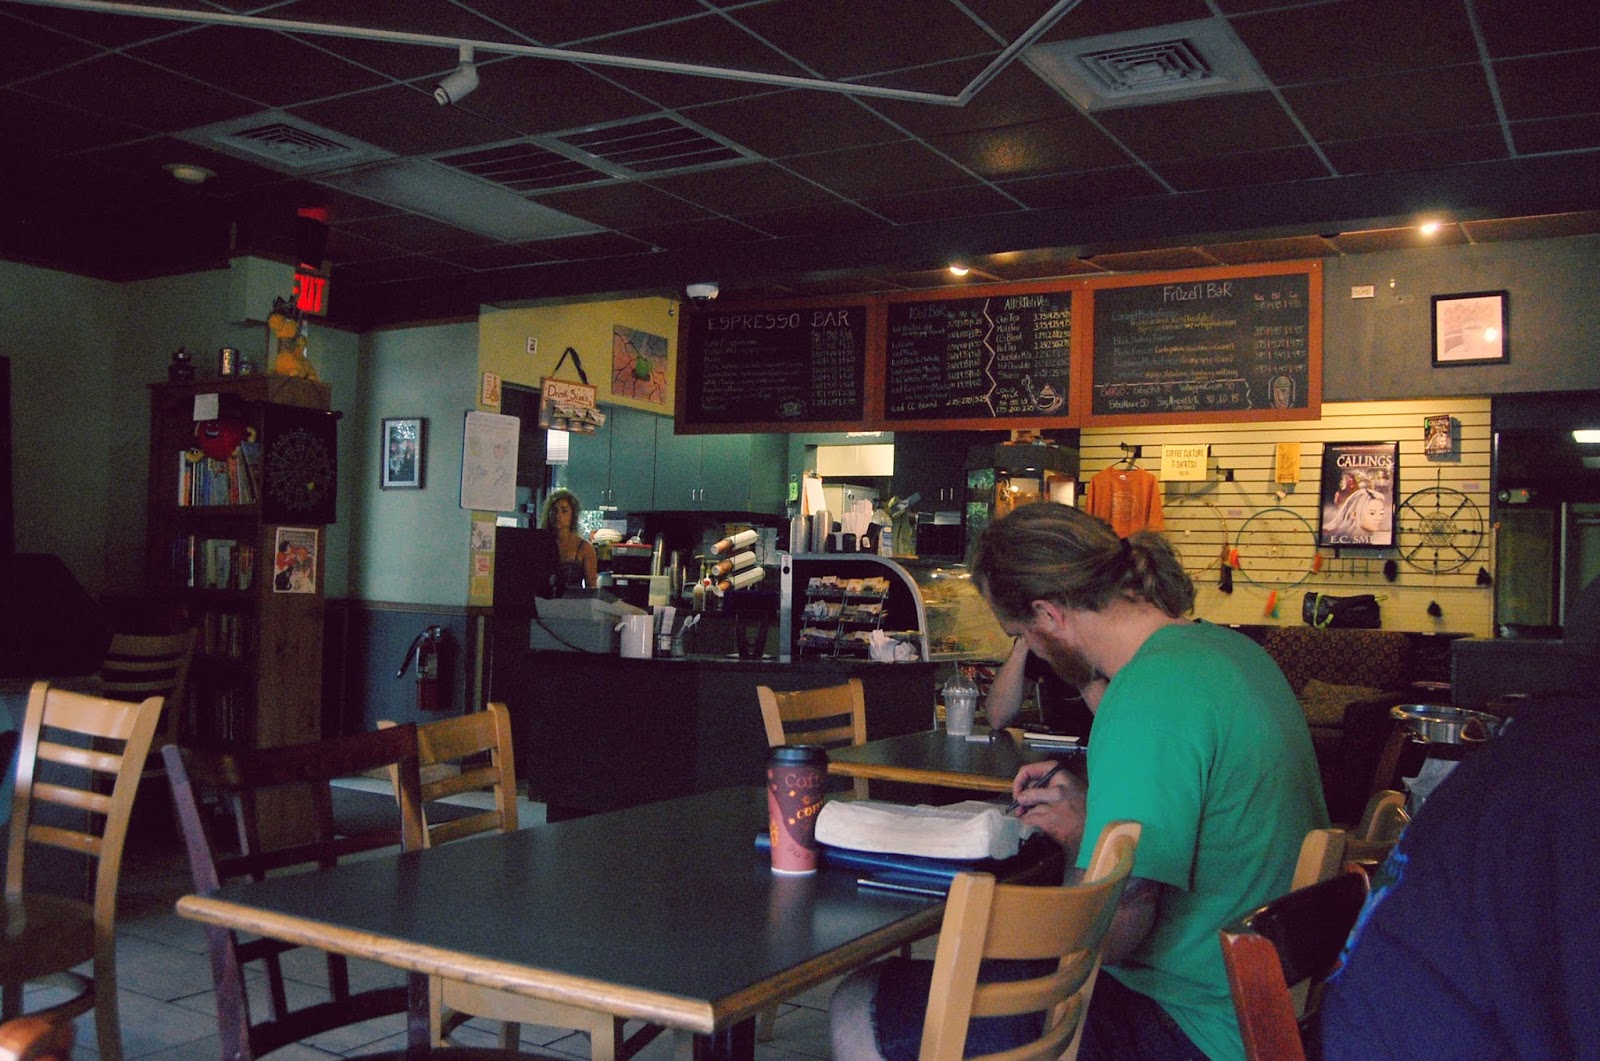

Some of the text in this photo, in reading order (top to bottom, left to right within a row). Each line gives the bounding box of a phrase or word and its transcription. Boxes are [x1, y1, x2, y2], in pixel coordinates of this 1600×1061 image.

[708, 310, 850, 330] ESPRESSO BAR
[1336, 455, 1393, 468] CALLINGS
[1353, 536, 1373, 544] SMI
